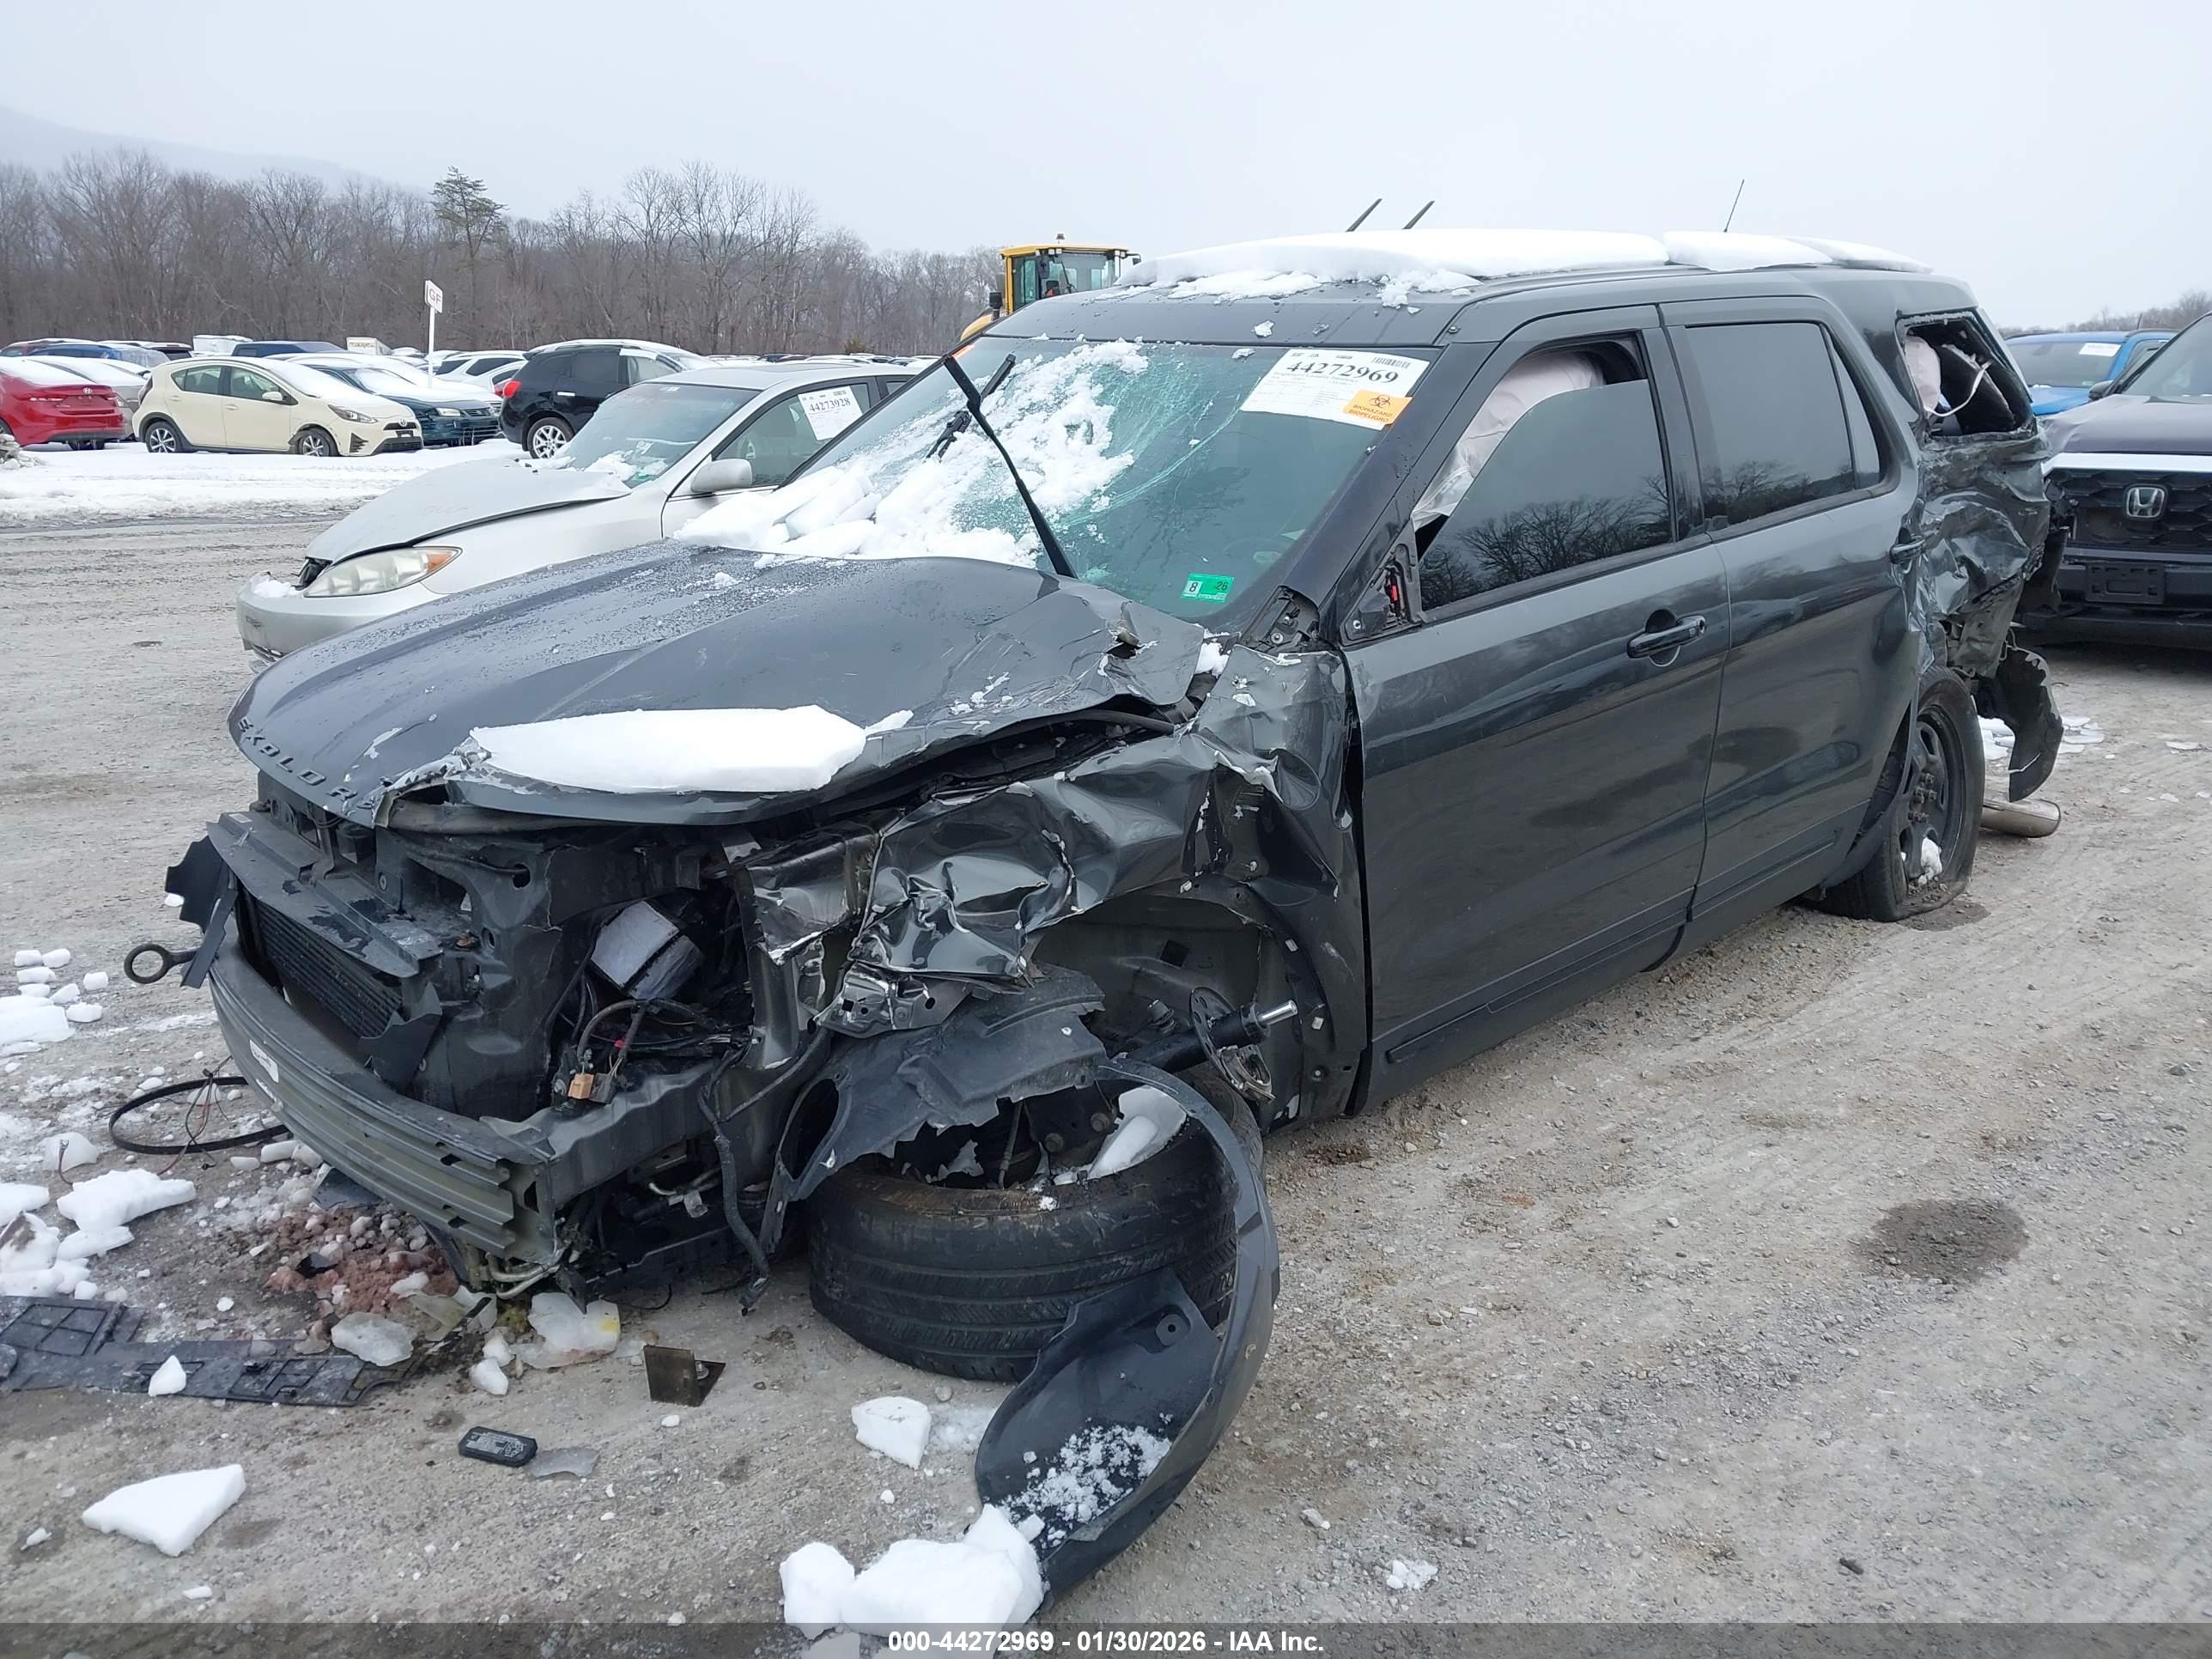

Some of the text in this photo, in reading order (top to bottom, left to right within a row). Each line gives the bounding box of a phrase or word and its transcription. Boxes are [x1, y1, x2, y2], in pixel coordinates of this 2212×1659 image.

[1286, 361, 1399, 384] 44272969
[809, 397, 851, 412] 44273928
[1352, 404, 1394, 417] BIOHAZARD
[1348, 409, 1389, 422] BIOPELIGRO
[1188, 581, 1199, 592] 8
